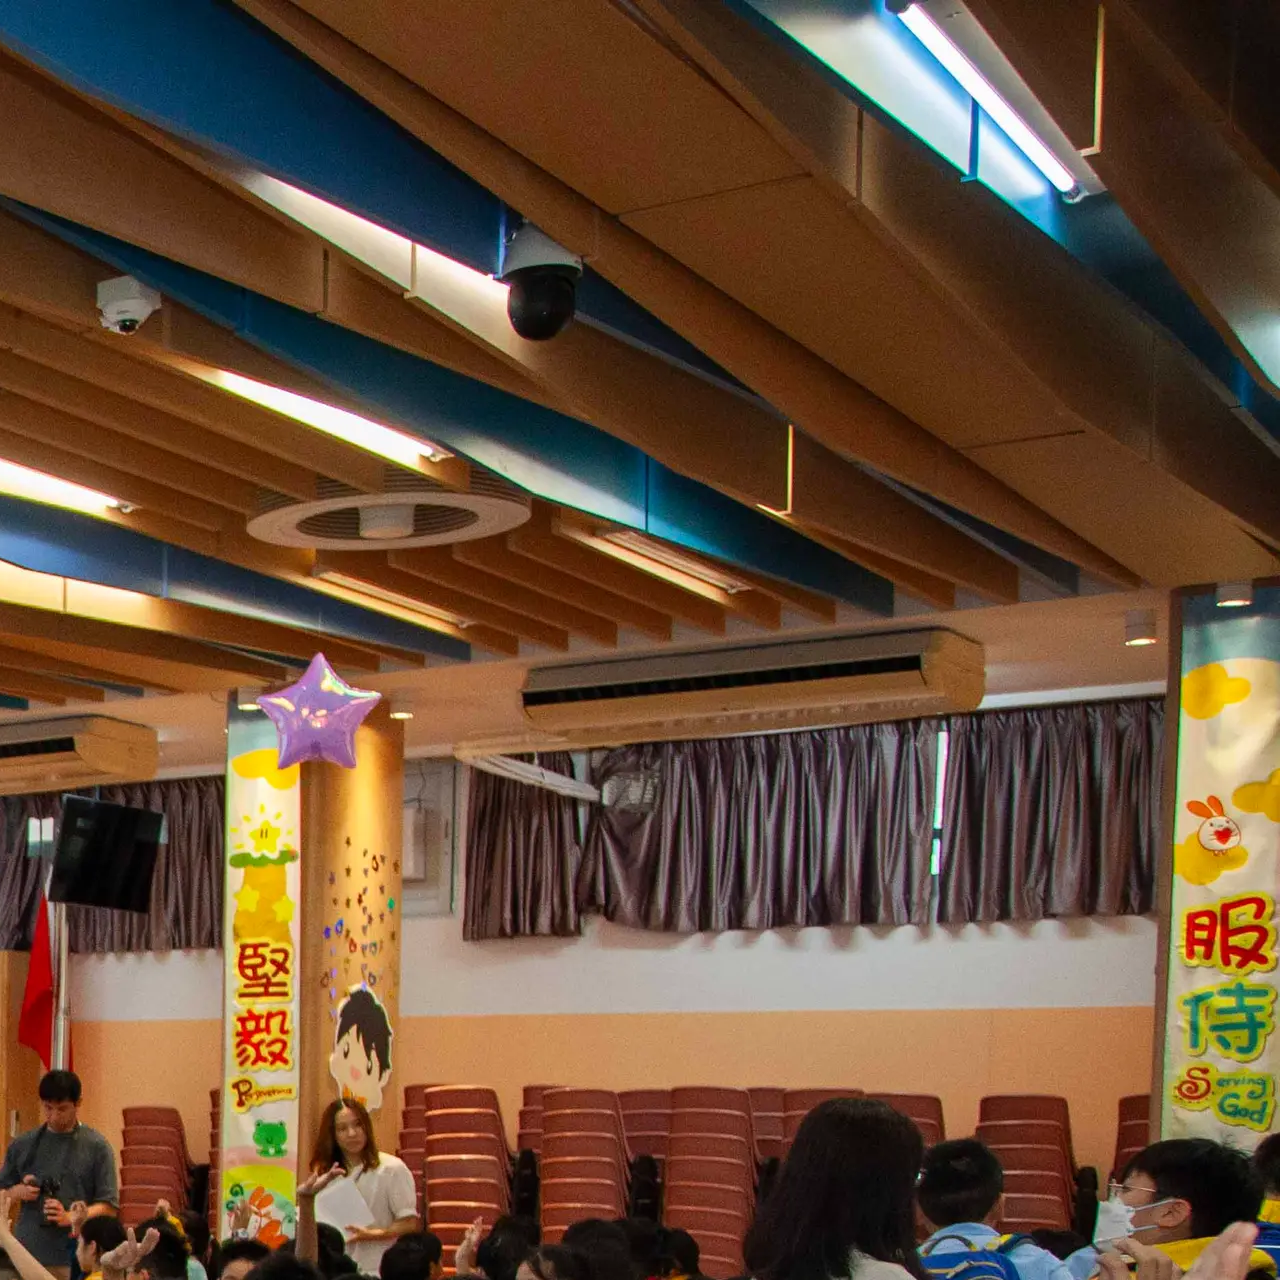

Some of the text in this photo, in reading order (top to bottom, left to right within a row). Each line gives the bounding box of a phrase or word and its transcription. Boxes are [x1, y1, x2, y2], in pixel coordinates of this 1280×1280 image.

[237, 942, 290, 1066] 堅毅
[1183, 896, 1269, 1055] 服侍
[1176, 1066, 1267, 1100] Serving
[1217, 1092, 1269, 1124] God
